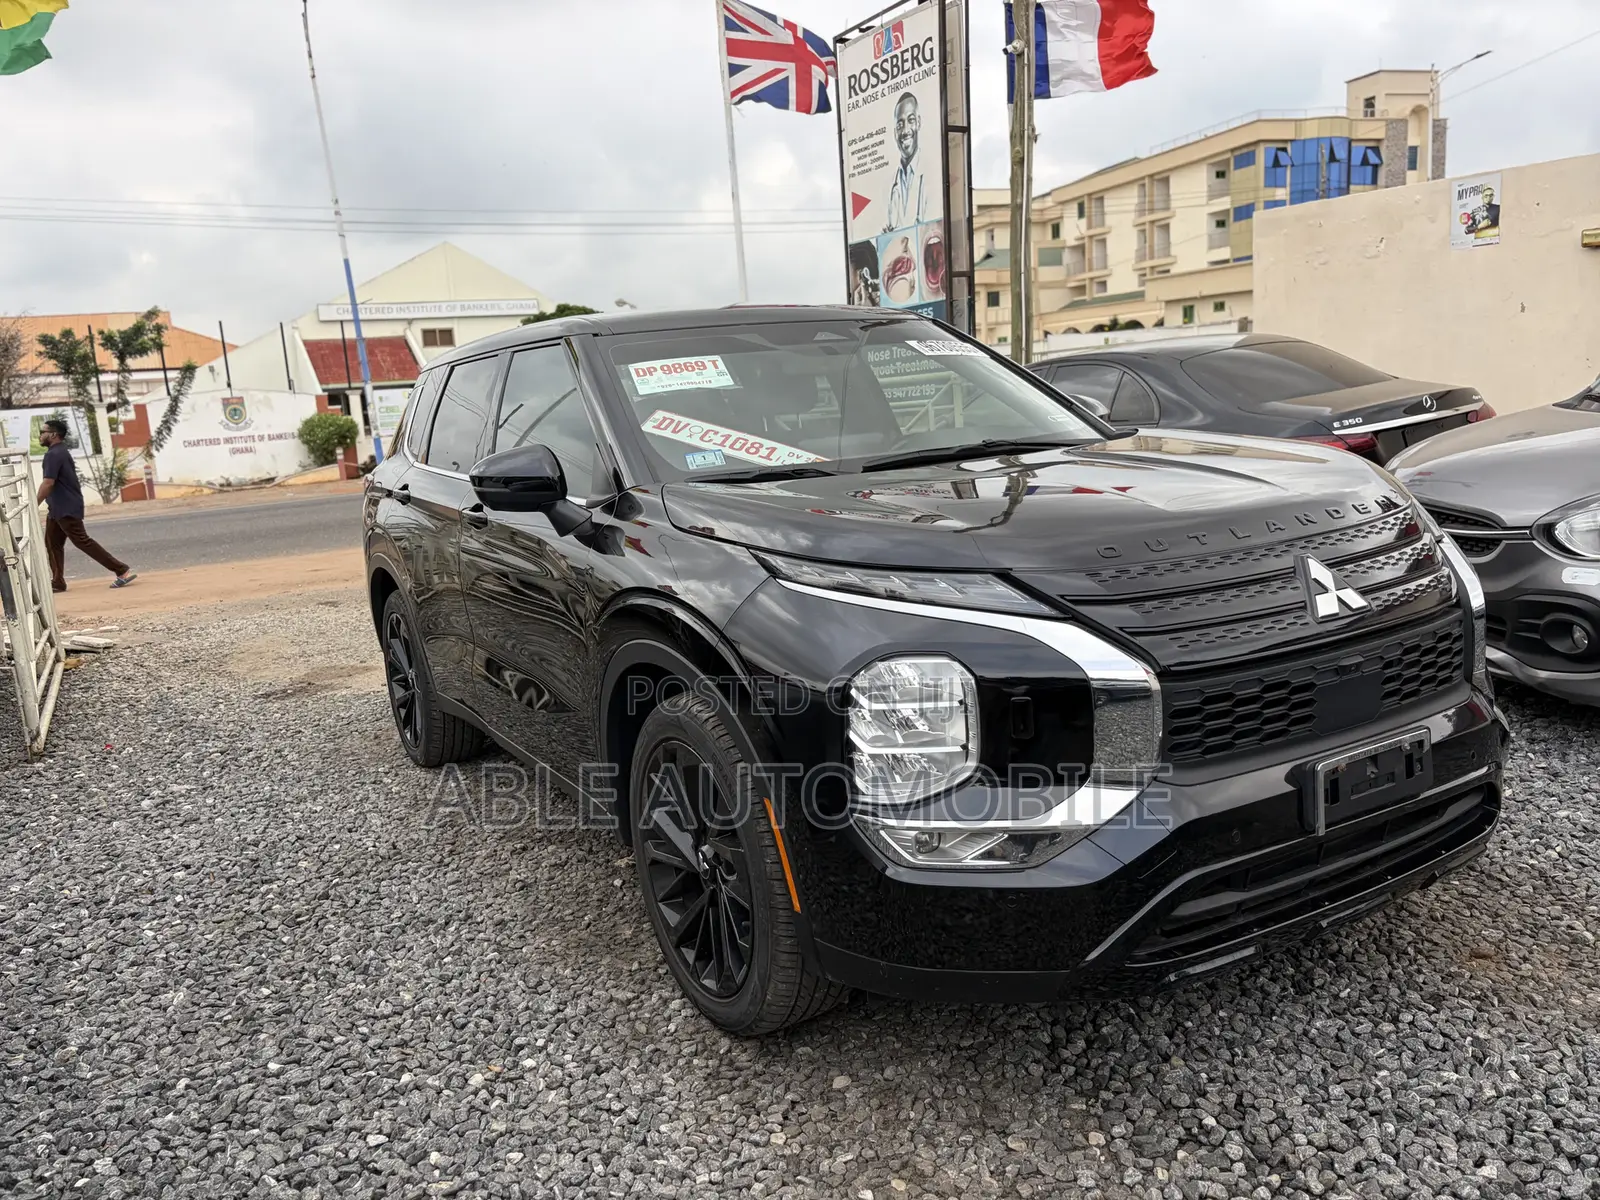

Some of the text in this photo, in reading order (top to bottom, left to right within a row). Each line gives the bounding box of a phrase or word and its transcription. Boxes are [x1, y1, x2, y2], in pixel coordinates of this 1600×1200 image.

[847, 36, 935, 99] ROSSBERG
[862, 91, 879, 107] NOSE
[880, 88, 886, 99] &
[887, 76, 913, 96] THROAT
[913, 65, 936, 84] CLINIC
[336, 306, 394, 316] CHRTERED
[396, 304, 444, 314] INSTITUTE
[445, 304, 457, 313] OF
[505, 302, 538, 311] GHANA
[868, 349, 890, 362] Nose
[634, 359, 720, 378] DP 9869 T
[1332, 416, 1363, 428] E 350
[183, 438, 221, 448] CHARTERED
[223, 434, 256, 445] INSTITUTE
[257, 433, 265, 442] OF
[652, 415, 690, 435] DV
[699, 429, 778, 461] C1081
[228, 445, 257, 457] (GHANA)
[1096, 493, 1400, 559] OUTLANDER
